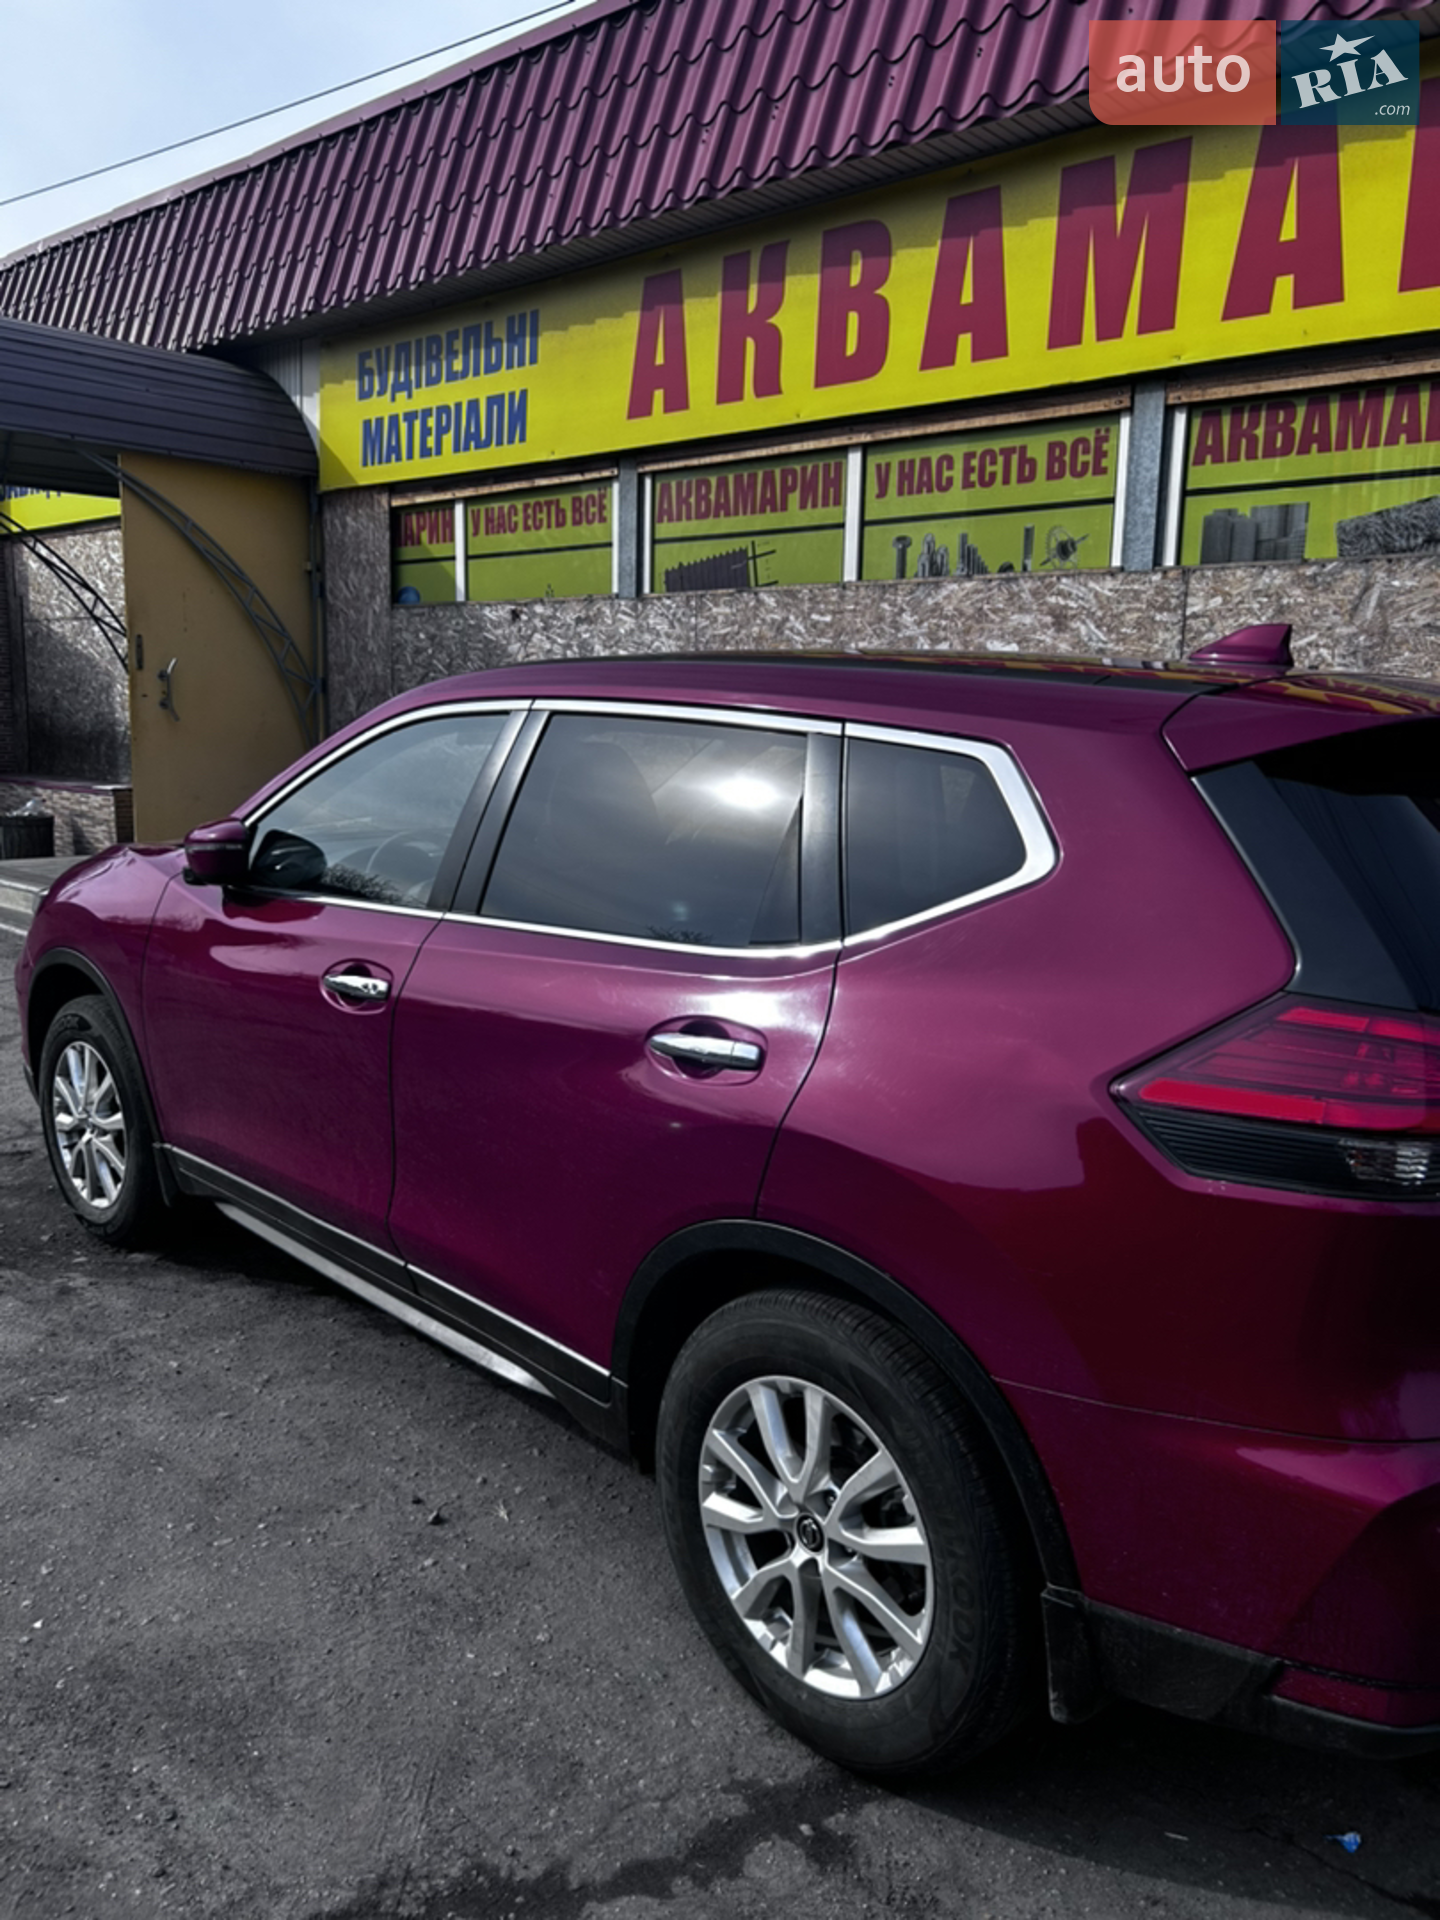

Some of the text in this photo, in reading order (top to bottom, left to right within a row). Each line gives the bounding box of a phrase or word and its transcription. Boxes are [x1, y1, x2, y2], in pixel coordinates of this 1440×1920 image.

[357, 309, 539, 402] БУДІВЕЛЬНІ
[361, 388, 528, 467] МАТЕРІАЛИ
[875, 427, 1112, 498] У НАС ЕСТЬ ВСЁ
[471, 486, 607, 537] У НАС ЕСТЬ ВСЁ
[656, 460, 843, 523] АКВАМАРИН
